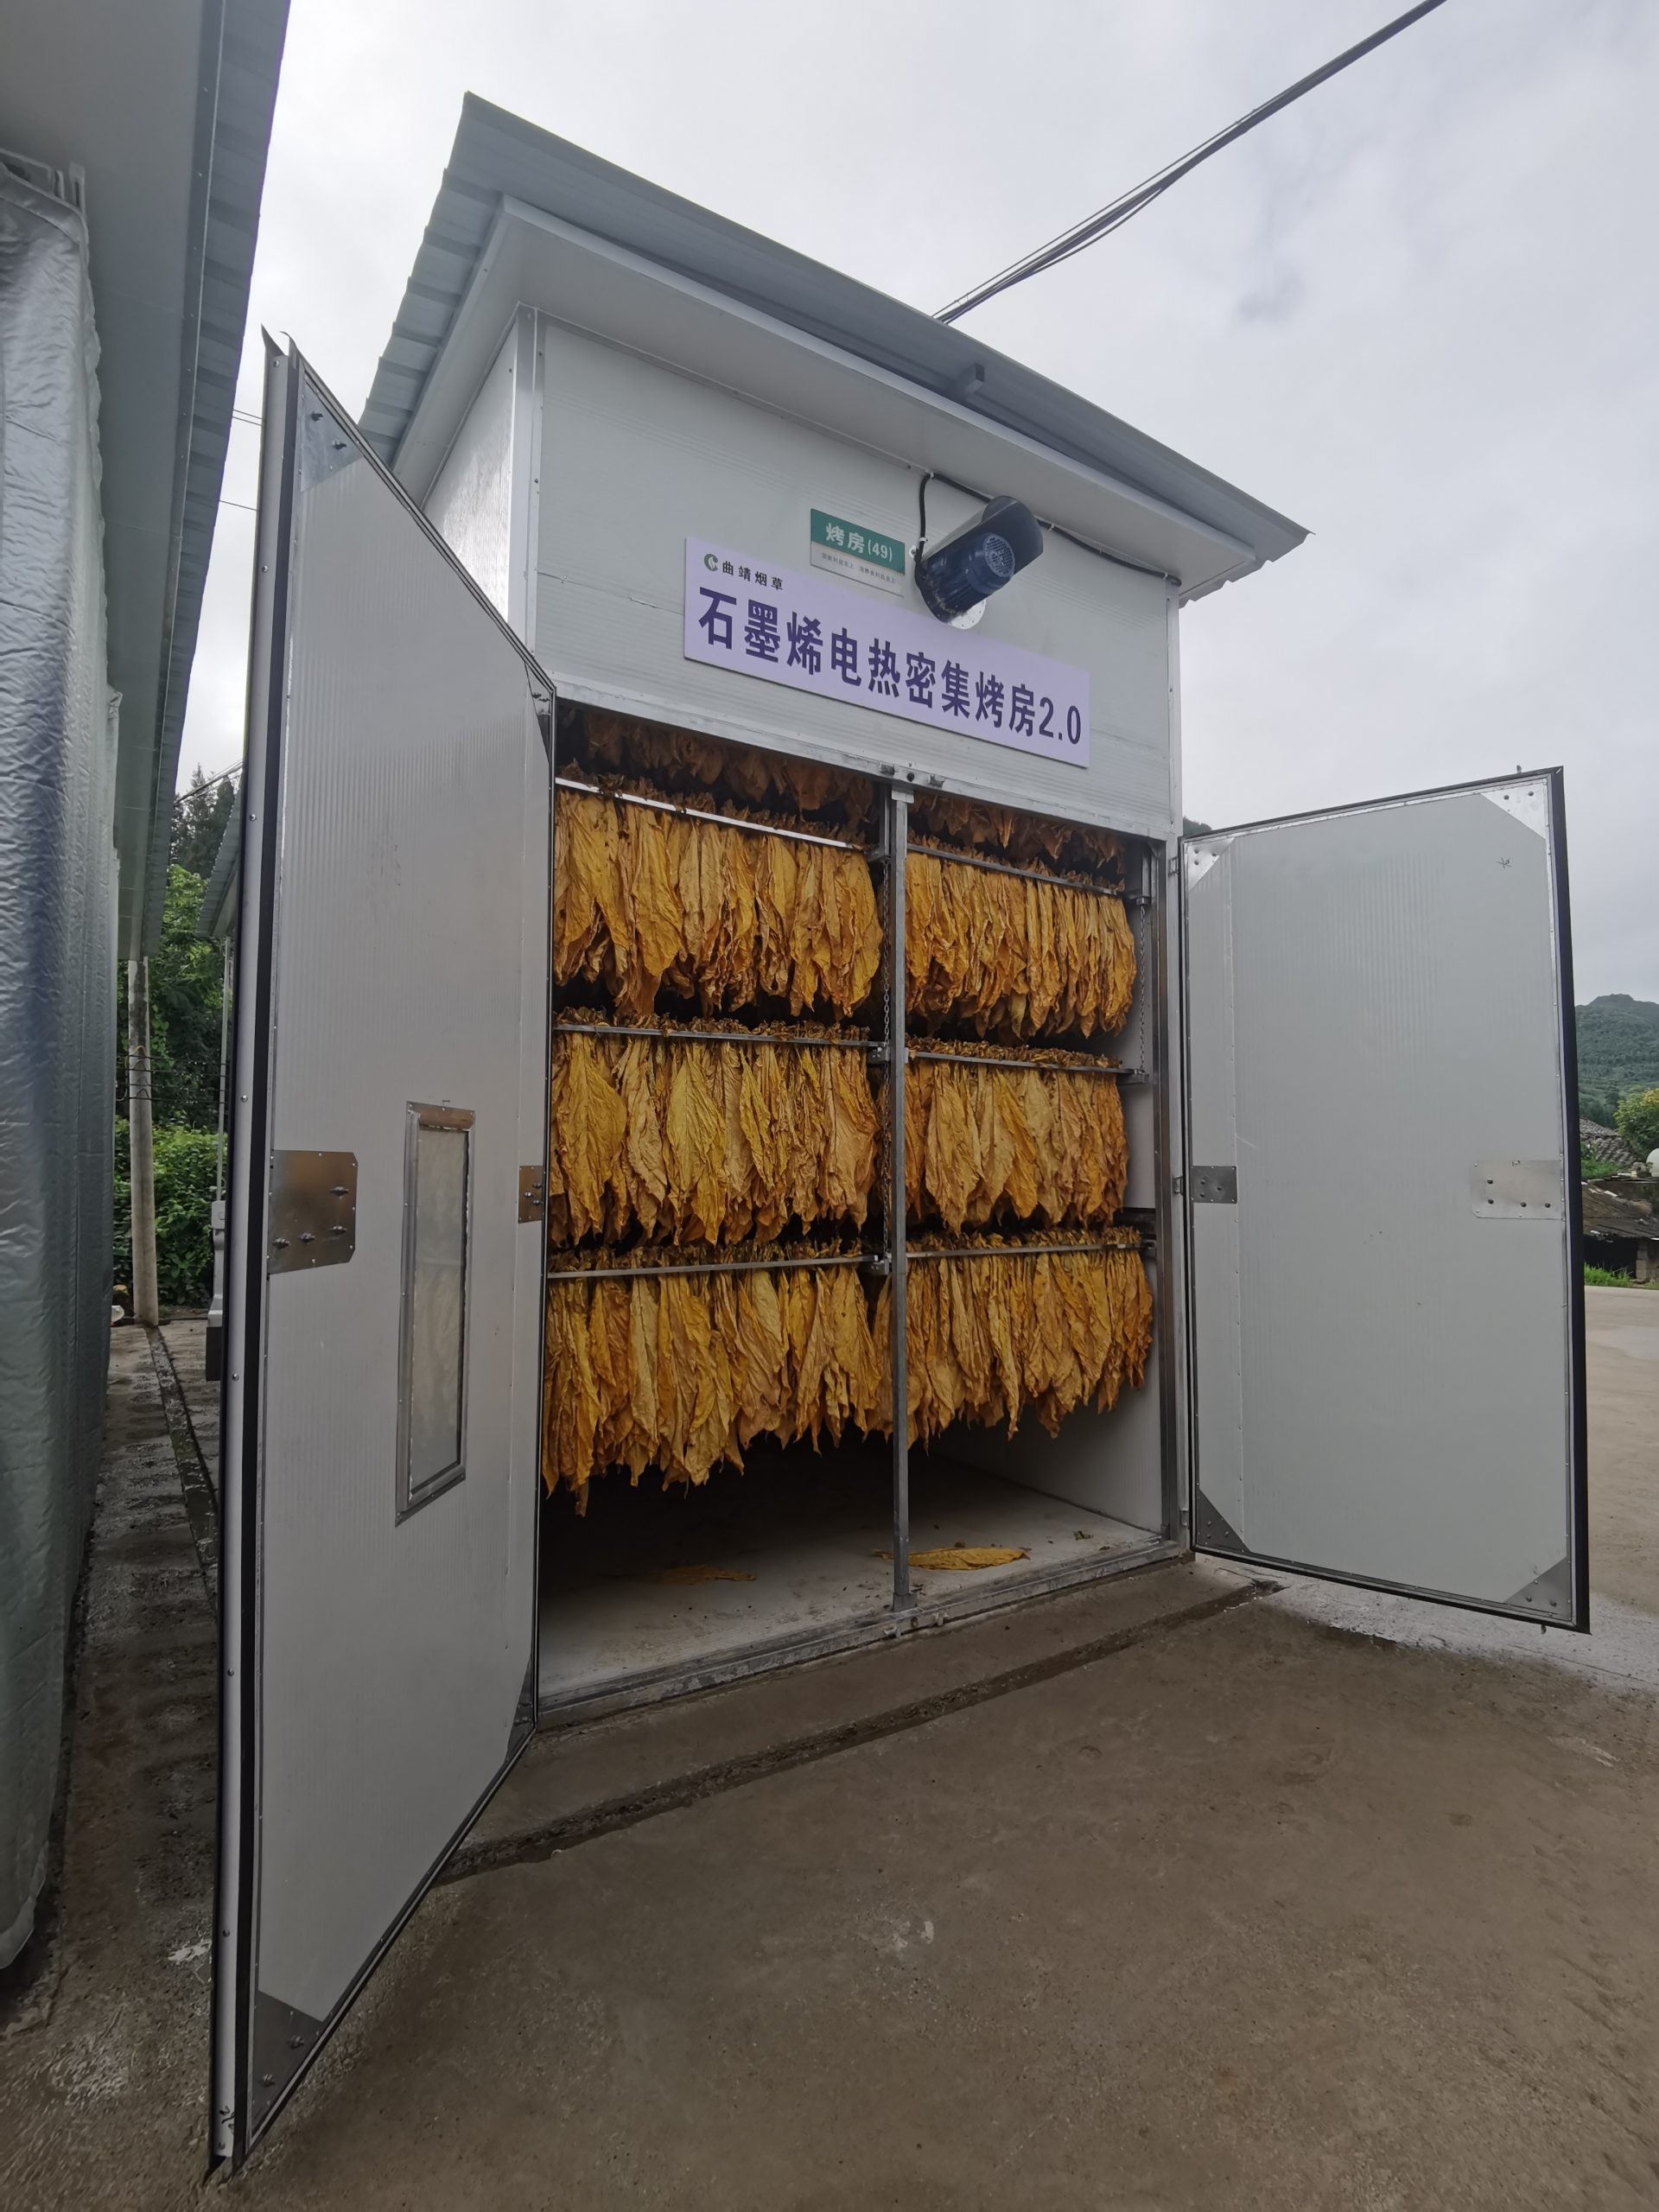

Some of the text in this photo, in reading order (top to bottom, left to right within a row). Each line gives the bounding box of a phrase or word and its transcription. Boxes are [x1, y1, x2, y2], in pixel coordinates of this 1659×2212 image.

[825, 522, 893, 563] 烤房(49)
[722, 560, 784, 591] 曲靖烟草
[698, 586, 1082, 746] 石墨烯电热密集烤房2.0
